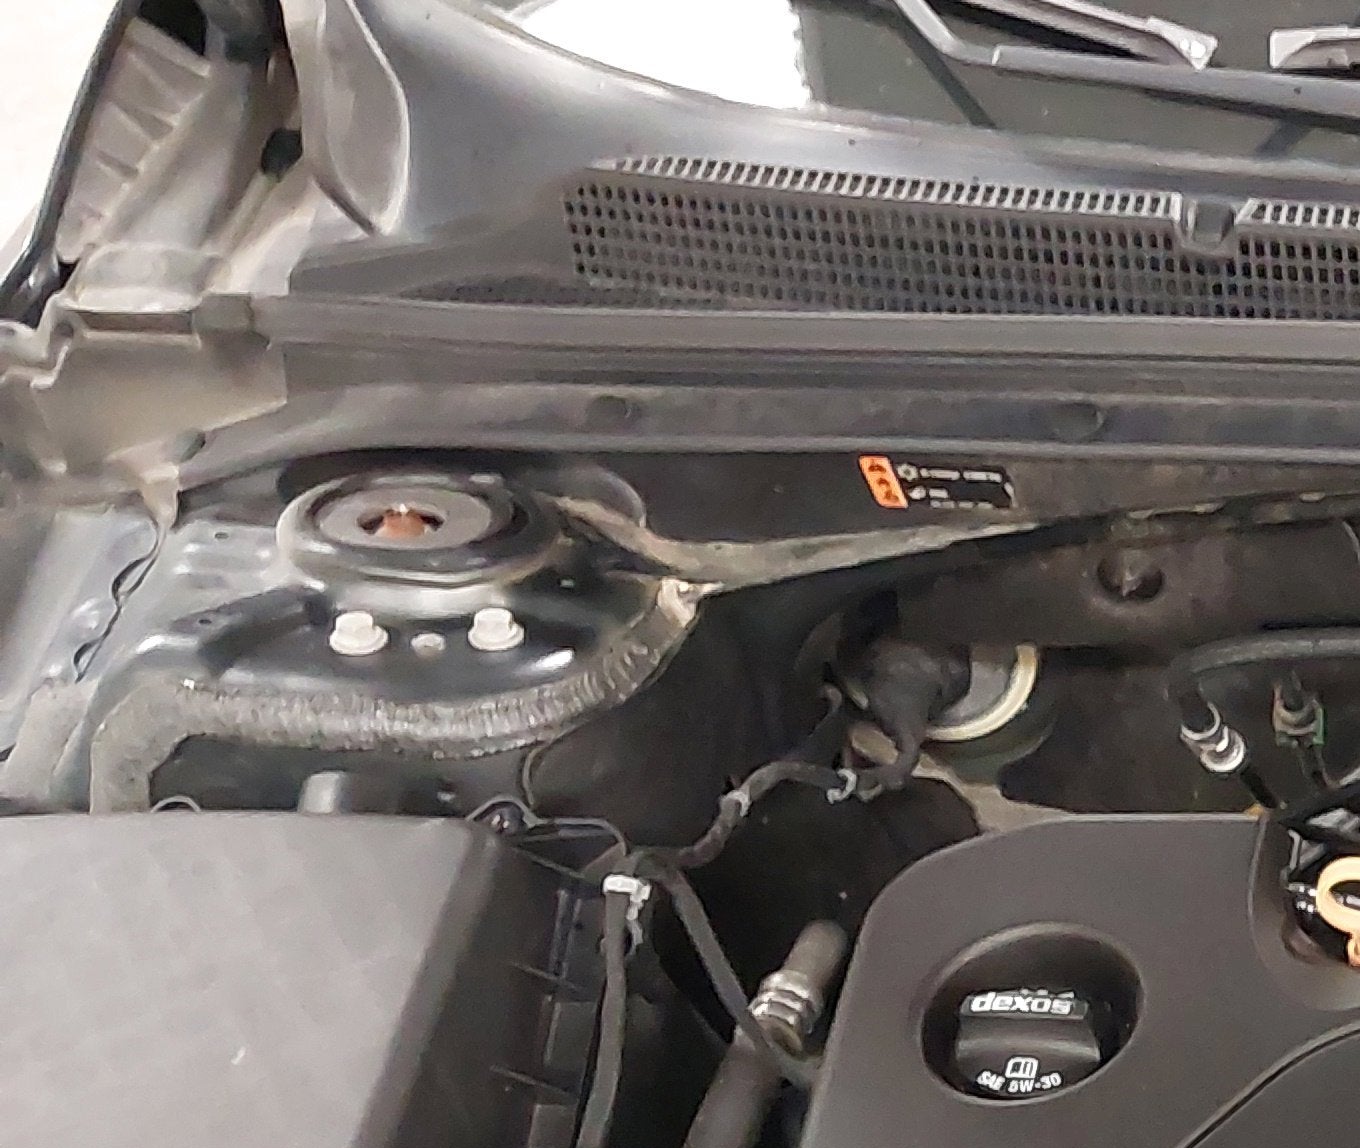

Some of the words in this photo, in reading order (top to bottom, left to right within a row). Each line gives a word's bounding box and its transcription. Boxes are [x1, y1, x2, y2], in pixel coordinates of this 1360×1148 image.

[970, 990, 1073, 1015] dexos
[976, 1070, 1006, 1091] SAE
[1007, 1072, 1062, 1093] 5W-30
